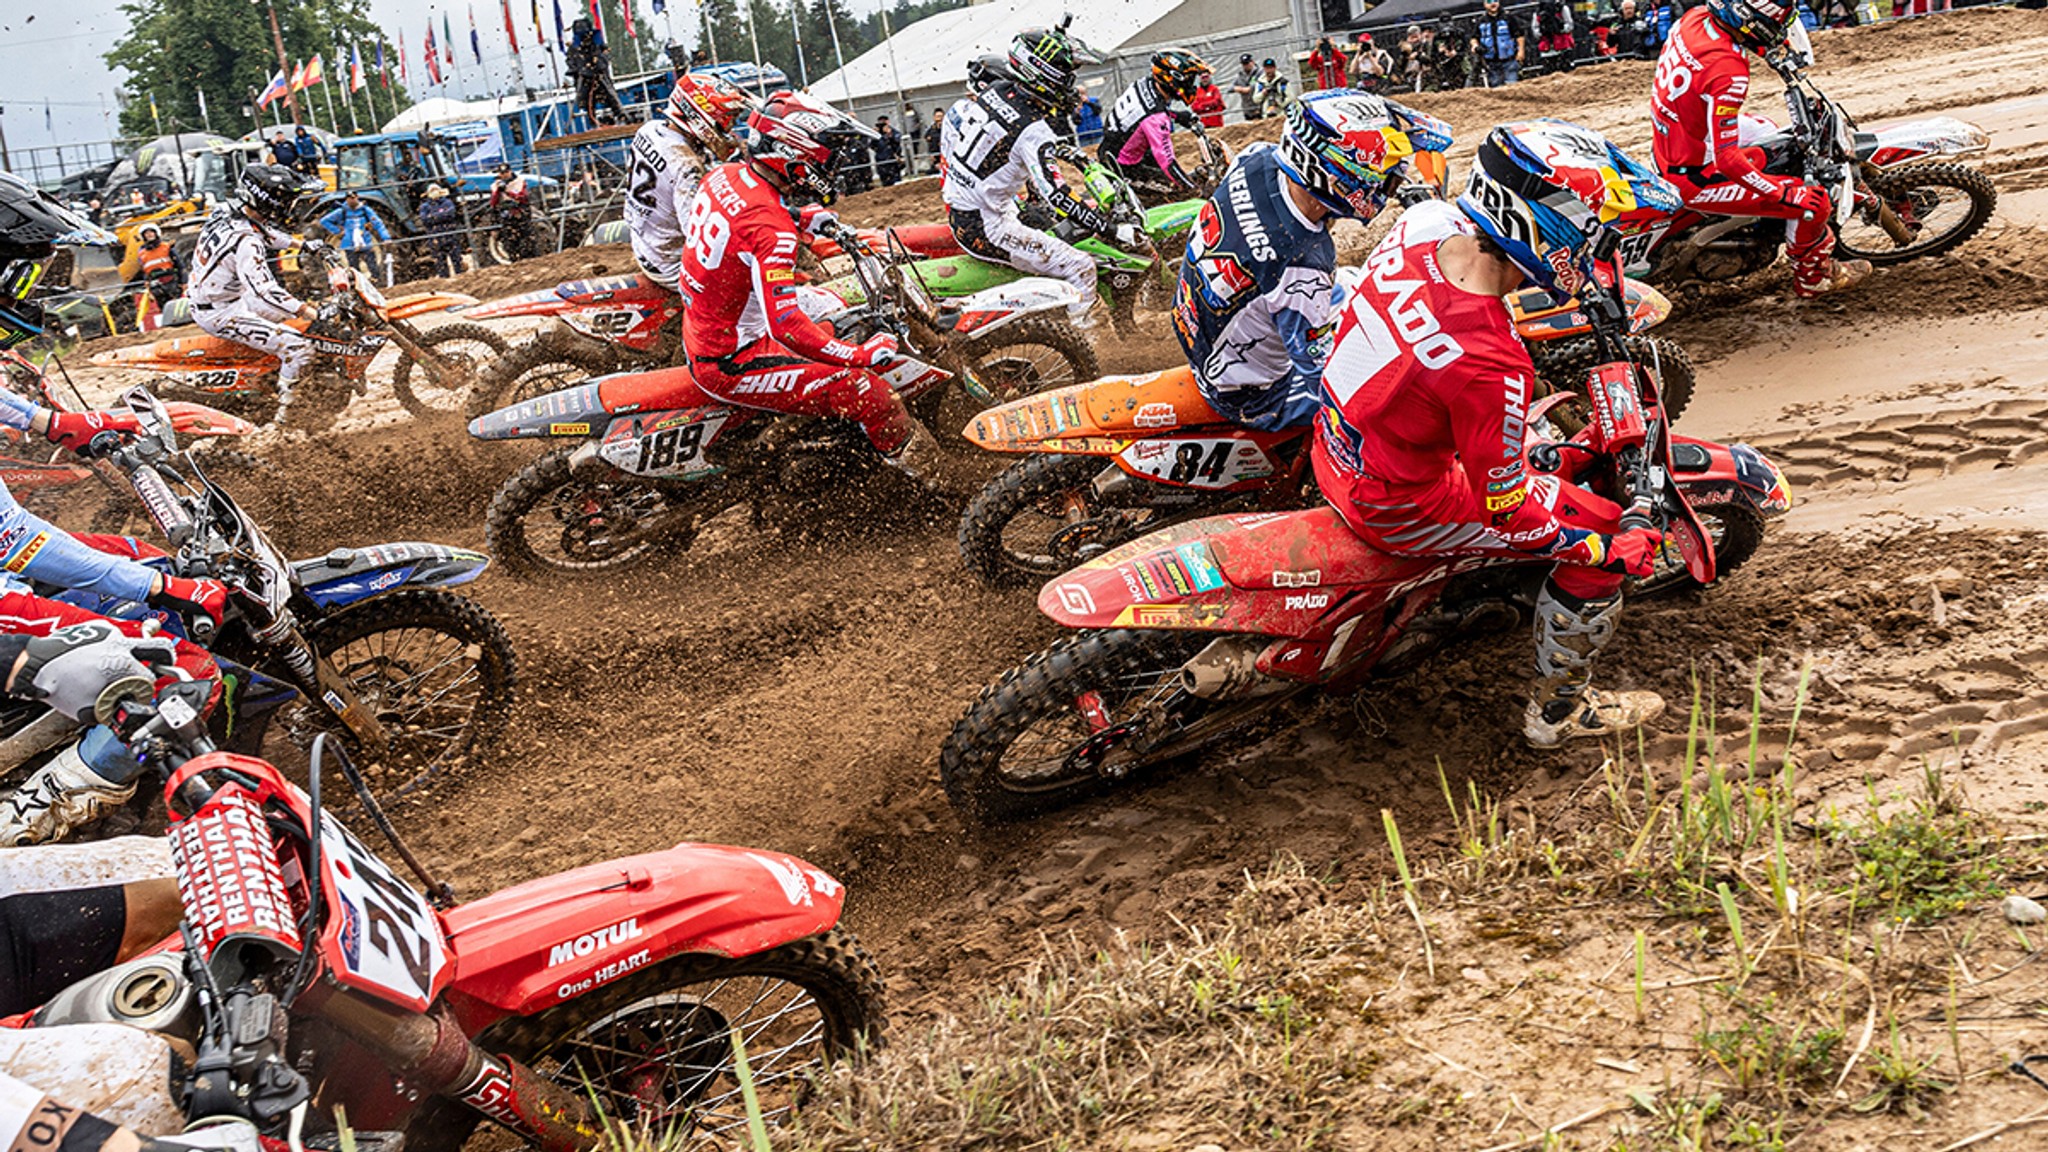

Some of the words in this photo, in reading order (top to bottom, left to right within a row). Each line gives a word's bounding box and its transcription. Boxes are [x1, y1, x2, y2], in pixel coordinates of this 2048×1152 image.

[1741, 170, 1779, 196] SHOT
[686, 188, 731, 270] 89
[1227, 166, 1278, 264] HERLINGS
[1422, 253, 1445, 285] THOR
[1621, 233, 1653, 269] 59
[1368, 221, 1465, 371] PRADO
[1570, 312, 1590, 326] Re
[311, 337, 365, 357] ABRIEL
[198, 369, 239, 388] 326
[729, 368, 806, 395] SHOT
[1502, 374, 1526, 459] THOR
[636, 422, 706, 473] 189
[1168, 440, 1236, 485] 84
[136, 471, 178, 530] RENTHAL
[1484, 514, 1562, 543] GASGA
[1117, 566, 1145, 603] AIROH
[1284, 592, 1329, 611] PRADO
[181, 820, 224, 941] RENTHAL
[201, 808, 249, 927] RENTHAL
[220, 791, 282, 933] RENTHAL
[547, 916, 644, 969] MOTUL
[557, 976, 593, 999] One
[594, 949, 653, 984] HEART.
[16, 1099, 74, 1152] OX
